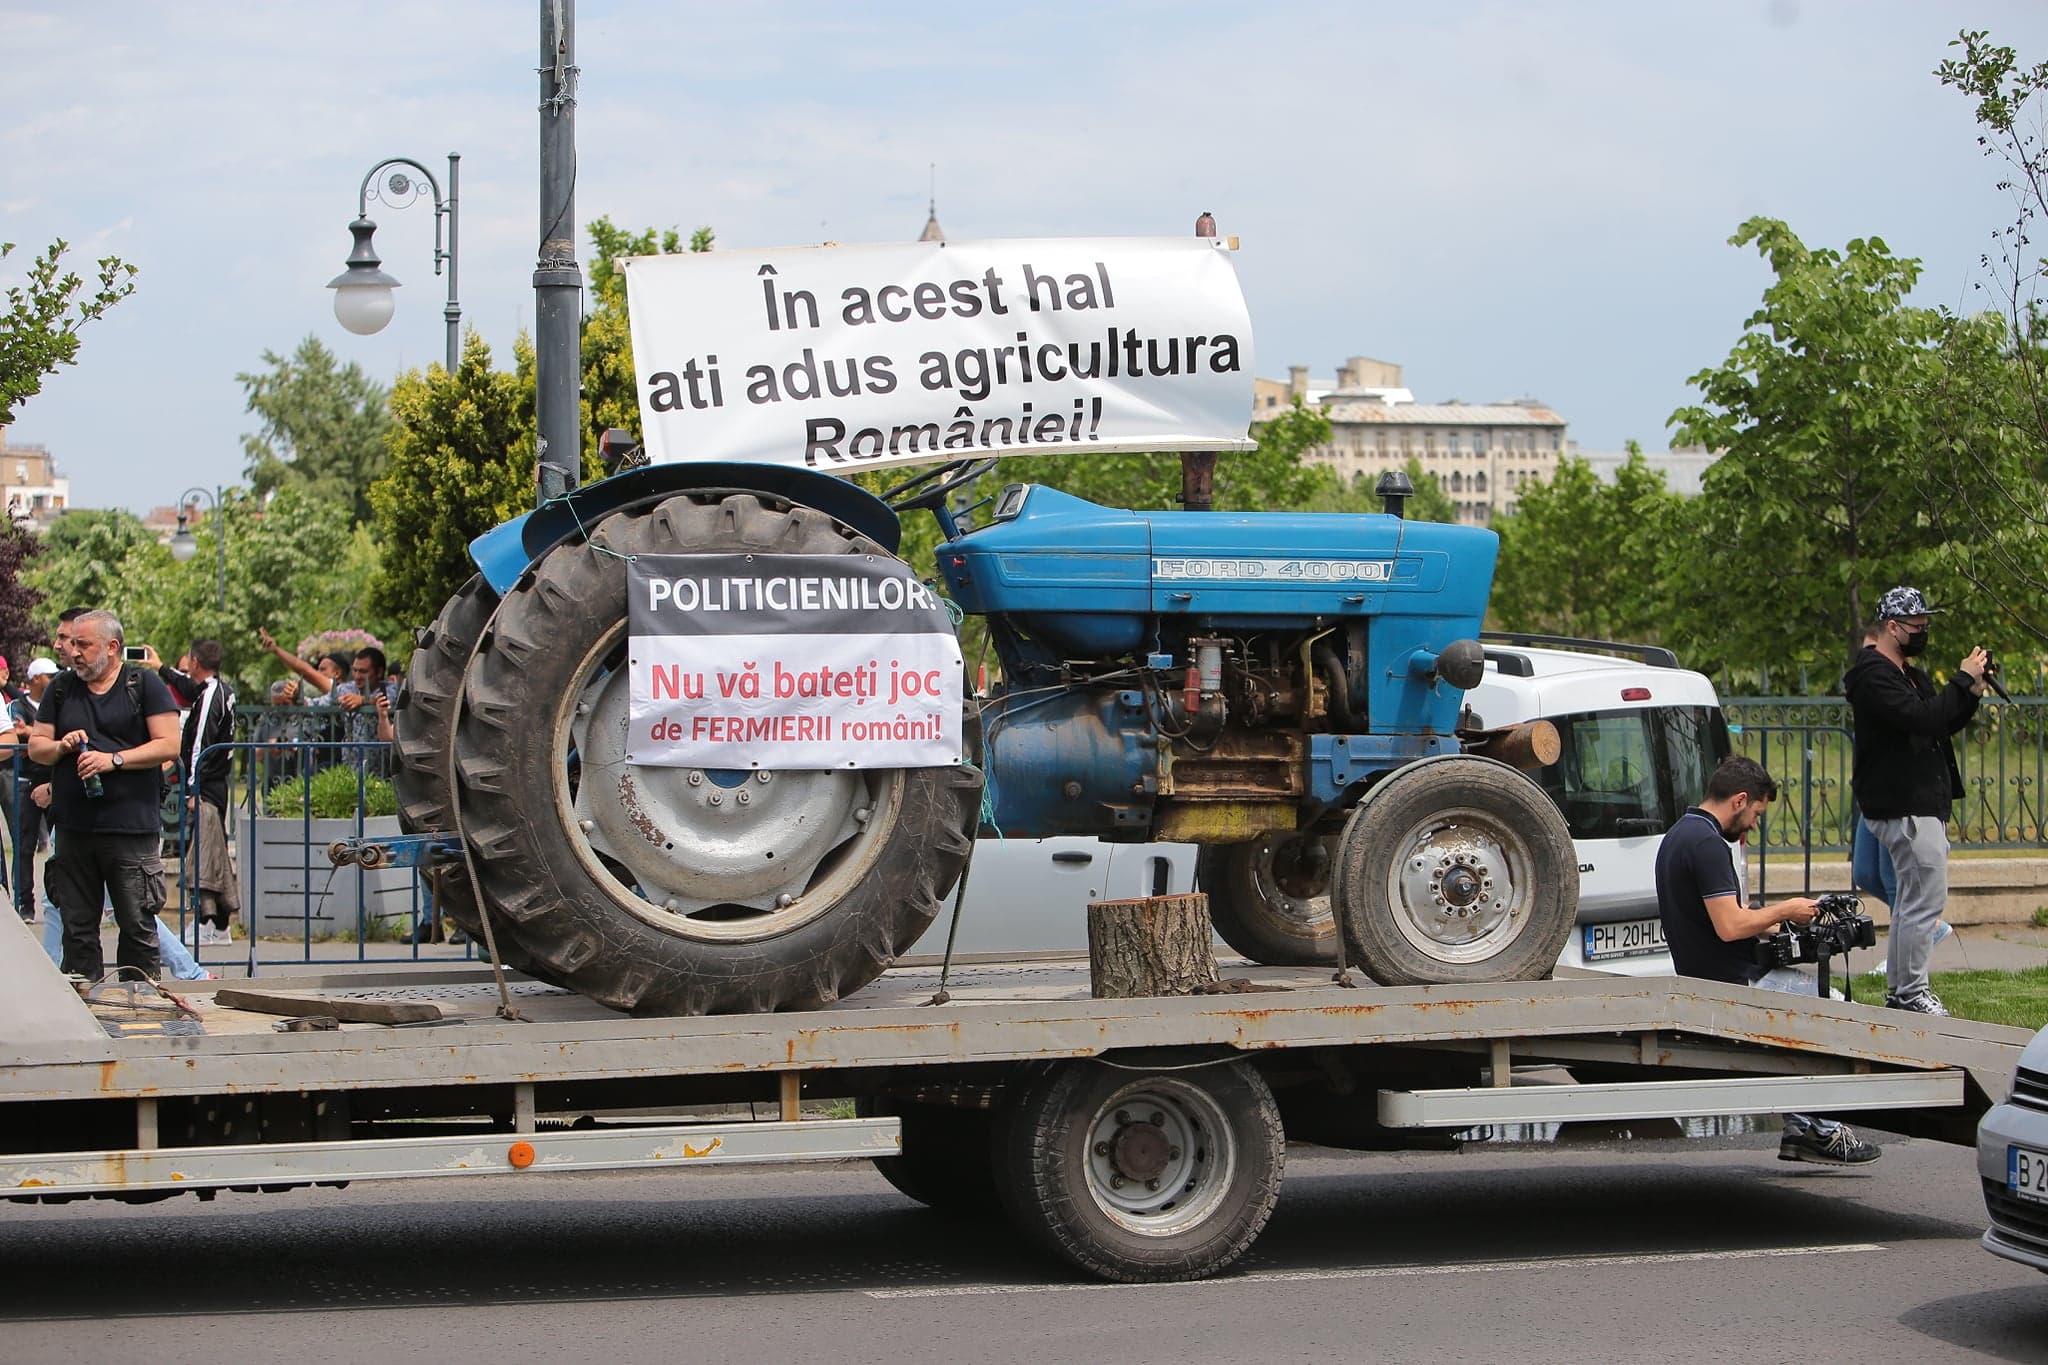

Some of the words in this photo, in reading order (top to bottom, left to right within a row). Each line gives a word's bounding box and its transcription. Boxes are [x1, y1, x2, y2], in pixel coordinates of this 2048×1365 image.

[757, 264, 819, 331] În
[842, 267, 1008, 325] acest
[1023, 262, 1116, 313] hal
[647, 354, 723, 413] ati
[745, 347, 898, 404] adus
[919, 326, 1241, 401] agricultura
[804, 397, 1103, 467] României!
[1160, 560, 1265, 577] FORD
[1278, 561, 1381, 579] 4000
[652, 664, 704, 700] Nu
[717, 661, 760, 699] vă
[774, 660, 878, 705] bateți
[887, 660, 941, 705] joc
[651, 717, 683, 741] de
[692, 715, 831, 742] FERMIERII
[841, 713, 942, 742] români!
[1594, 925, 1616, 950] PH
[2019, 1153, 2030, 1187] B
[2036, 1159, 2048, 1192] 2
